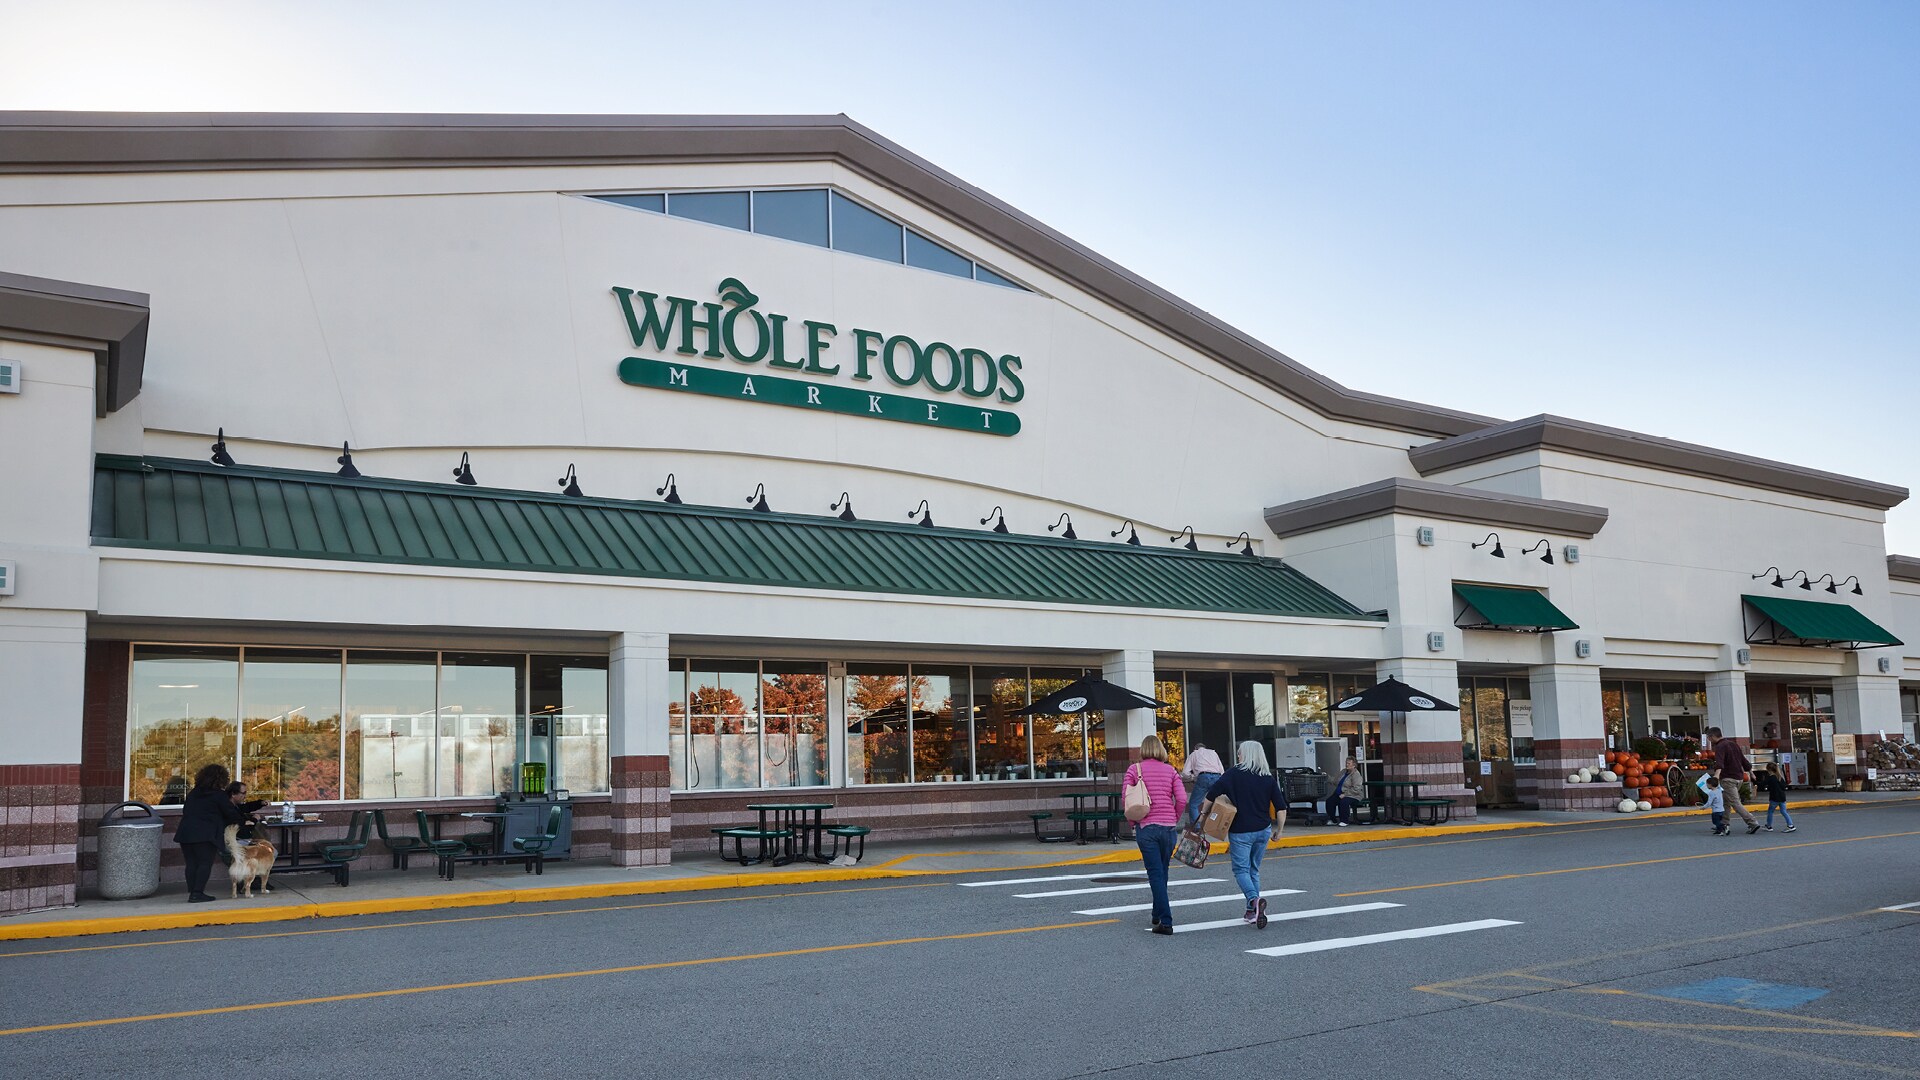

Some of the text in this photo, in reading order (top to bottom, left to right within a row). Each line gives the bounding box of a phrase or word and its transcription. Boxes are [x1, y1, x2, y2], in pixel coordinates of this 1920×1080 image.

[610, 277, 1025, 404] WHOLE FOODS
[669, 366, 993, 429] MARKET
